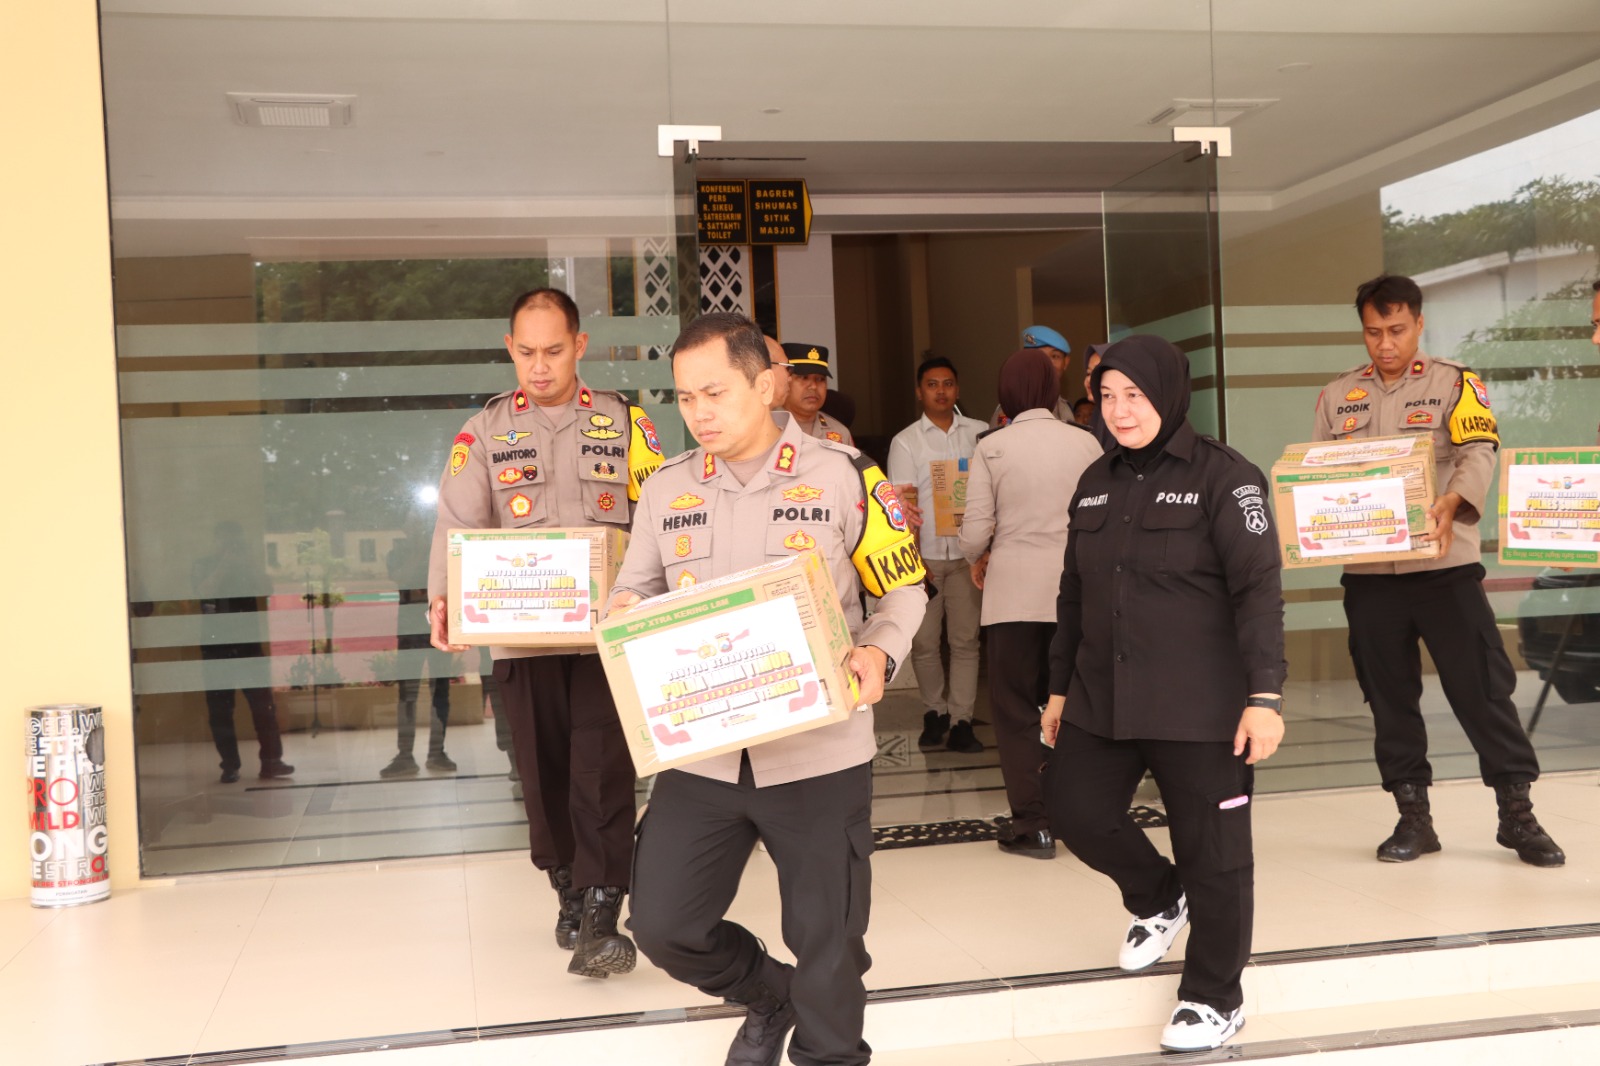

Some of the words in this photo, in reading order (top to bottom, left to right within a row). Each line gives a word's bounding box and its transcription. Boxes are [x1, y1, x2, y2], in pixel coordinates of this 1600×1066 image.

[701, 185, 742, 193] KONFERENSI
[756, 190, 795, 198] BAGREN
[708, 194, 727, 202] PERS
[712, 203, 733, 211] SIKEU
[755, 202, 798, 210] SIHUMAS
[764, 214, 790, 222] SITIK
[707, 222, 740, 230] SATTAHTI
[760, 226, 795, 234] MASJID
[707, 231, 731, 239] TOILET
[1405, 399, 1441, 408] POLRI
[1337, 403, 1370, 415] DODIK
[492, 448, 537, 464] BIANTORO
[581, 444, 625, 459] POLRI
[1155, 492, 1199, 505] POLRI
[772, 507, 830, 522] POLRI
[662, 512, 708, 531] HENRI
[478, 577, 512, 590] POLDA
[511, 576, 541, 590] JAWA
[540, 576, 576, 589] TIMUR
[648, 614, 672, 627] XTRA
[673, 604, 709, 620] KERING
[660, 676, 708, 701] POLDA
[706, 664, 748, 689] JAWA
[746, 651, 794, 677] TIMUR
[757, 678, 801, 701] TENGAH
